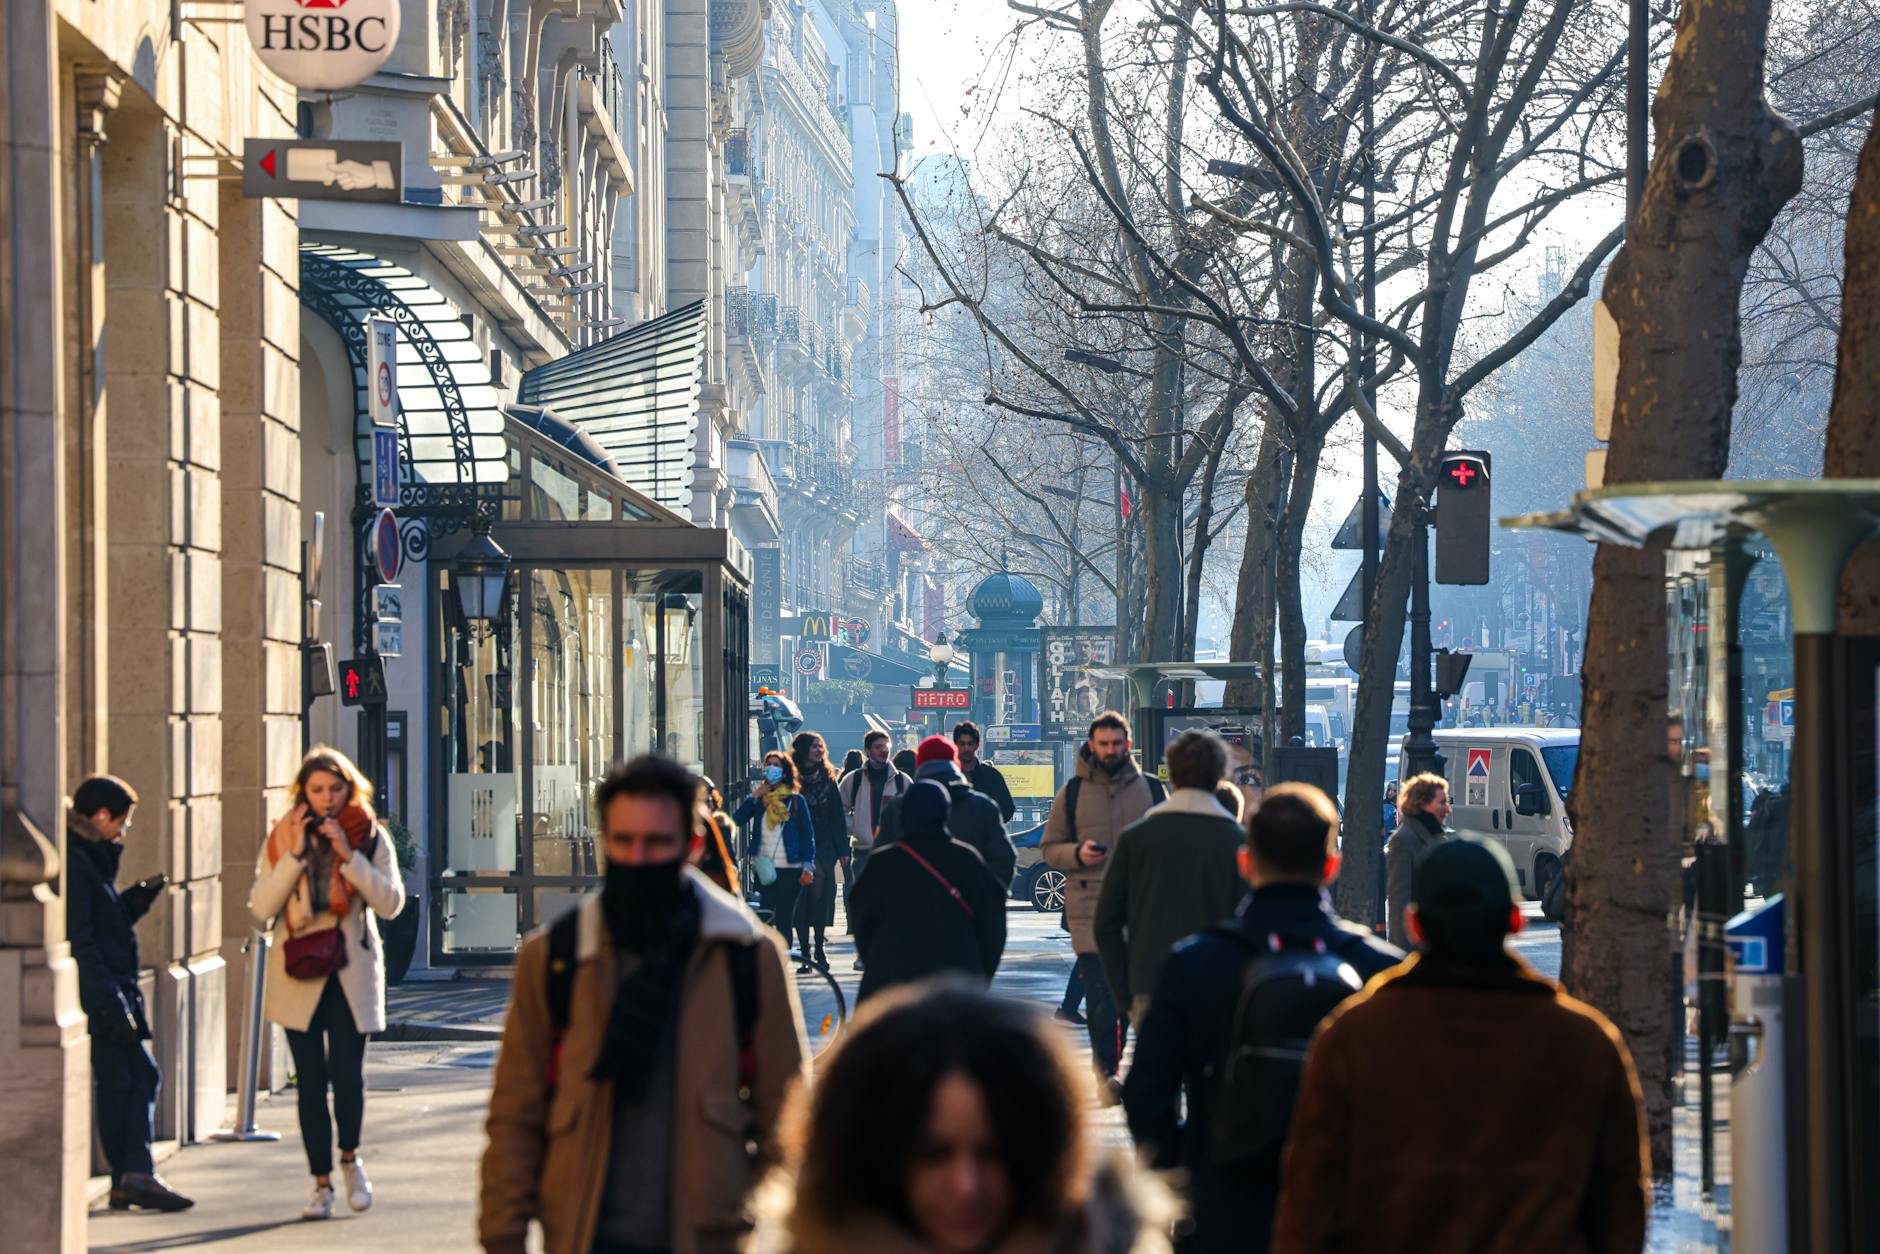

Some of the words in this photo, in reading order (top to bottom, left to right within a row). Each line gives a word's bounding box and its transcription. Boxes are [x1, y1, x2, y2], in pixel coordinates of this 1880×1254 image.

[260, 14, 387, 53] HSBC
[760, 601, 773, 620] DE
[1049, 641, 1065, 723] GOLIATH
[917, 693, 966, 706] METRO
